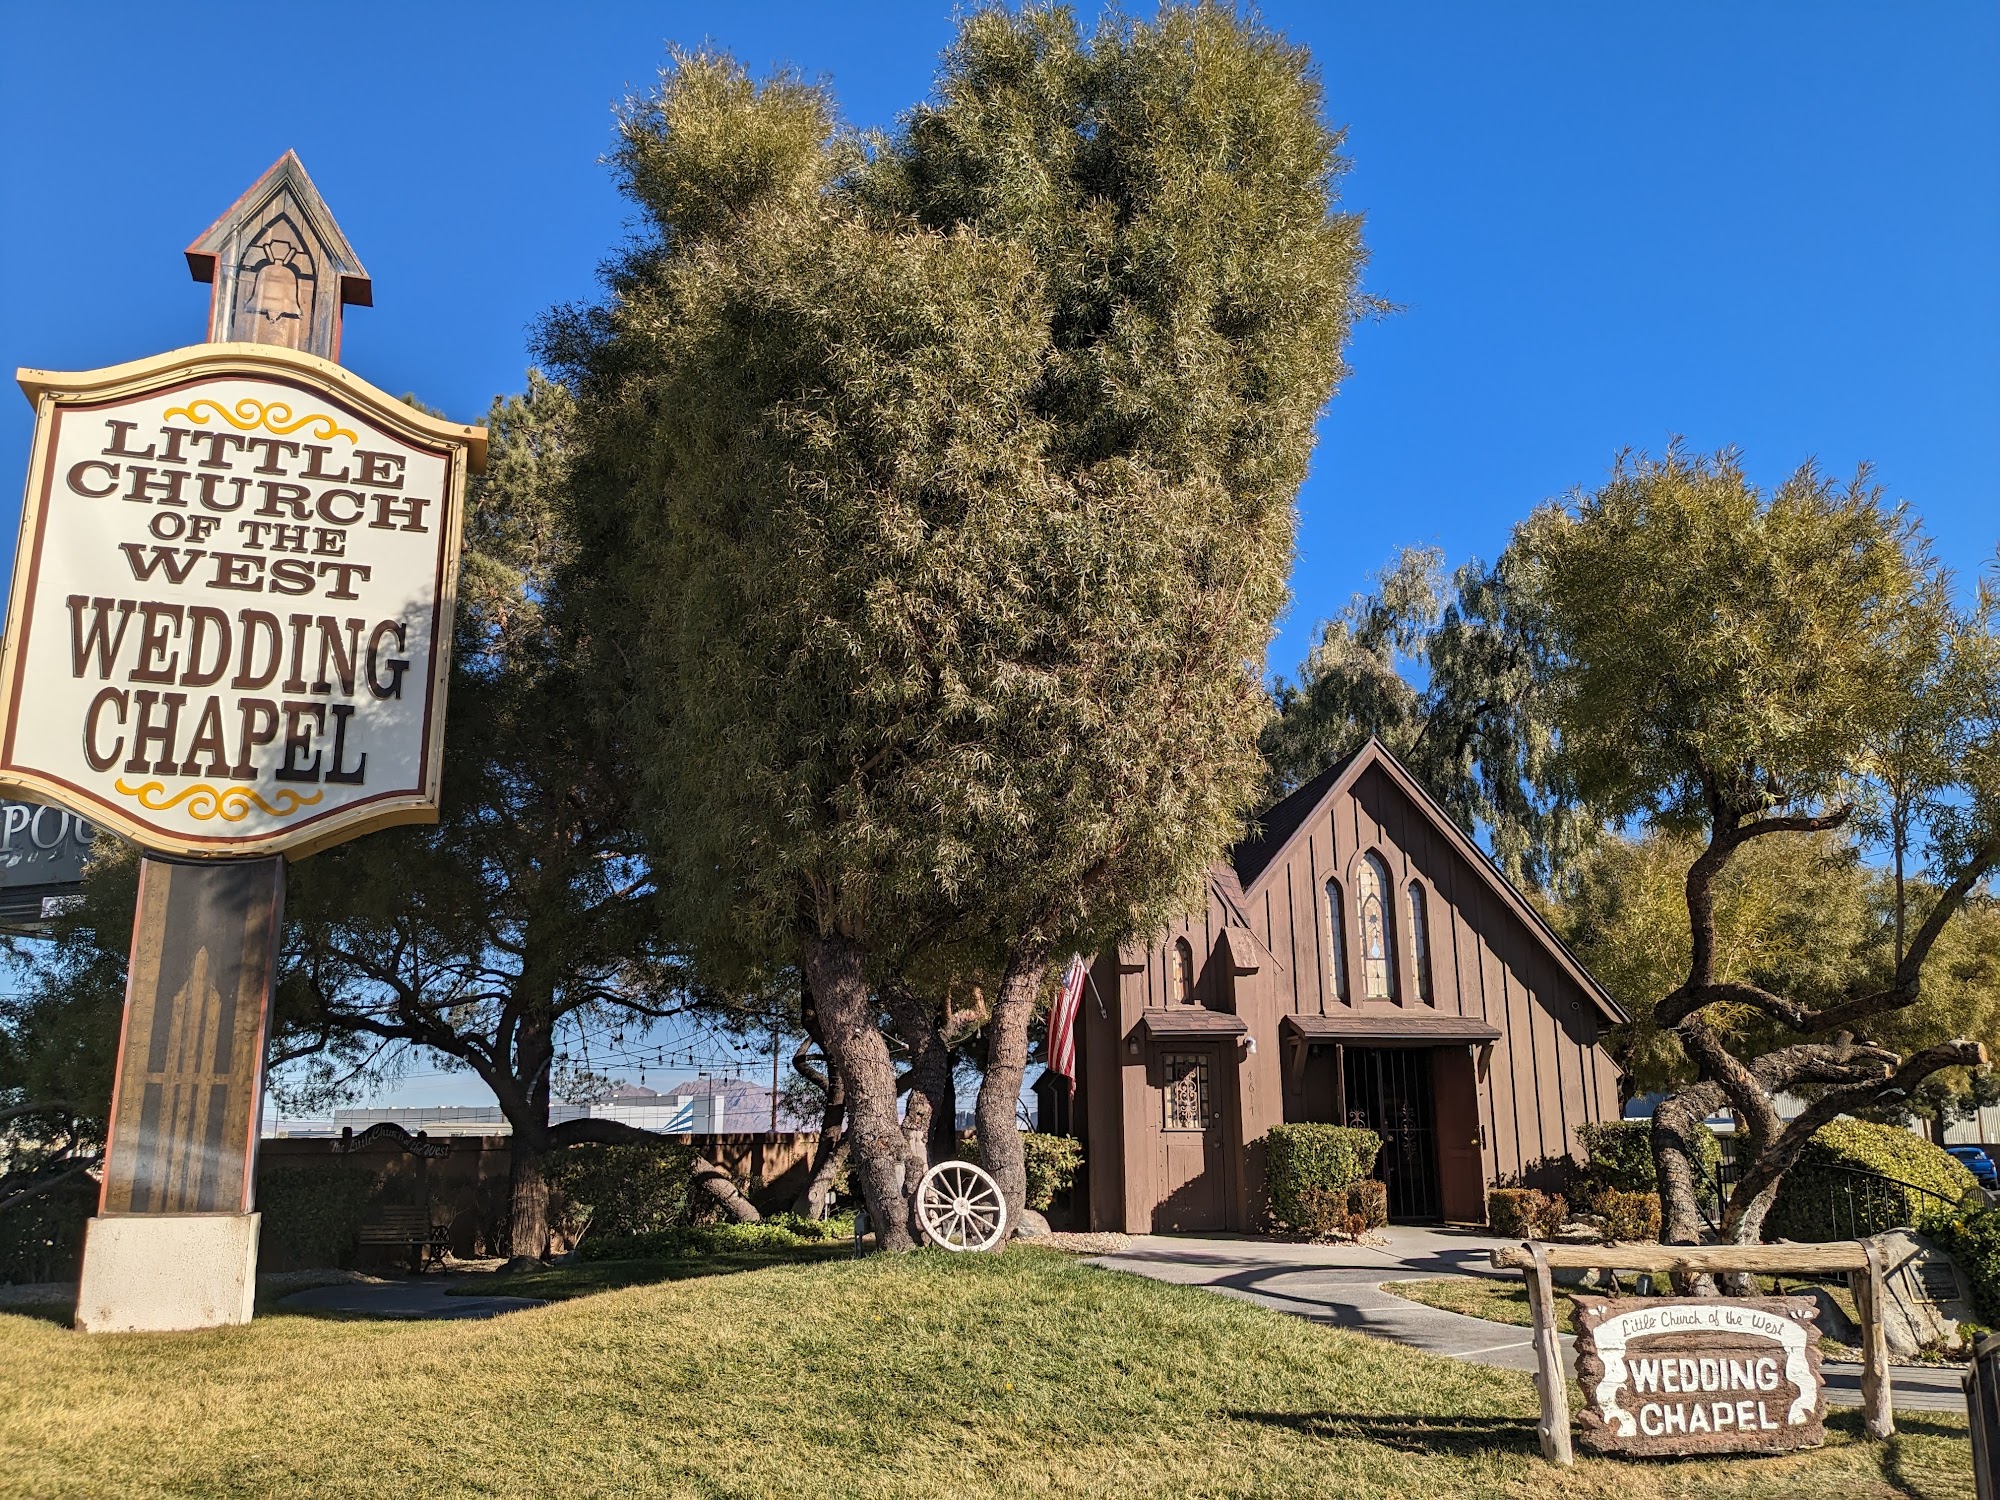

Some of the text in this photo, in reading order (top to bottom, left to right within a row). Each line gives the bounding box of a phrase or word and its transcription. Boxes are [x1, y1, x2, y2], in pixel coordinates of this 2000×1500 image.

[101, 419, 407, 490] LITTLE
[66, 459, 431, 533] CHURCH
[148, 511, 348, 557] OF THE
[119, 542, 372, 600] WEST
[66, 594, 411, 701] WEDDING
[82, 686, 368, 785] CHAPEL
[329, 1140, 345, 1153] The
[348, 1136, 372, 1153] Little
[372, 1126, 404, 1141] Church
[409, 1142, 423, 1155] the
[423, 1144, 449, 1156] West
[1622, 1310, 1785, 1337] Little Church of the West
[1628, 1357, 1778, 1393] WEDDING
[1640, 1400, 1779, 1436] CHAPEL
